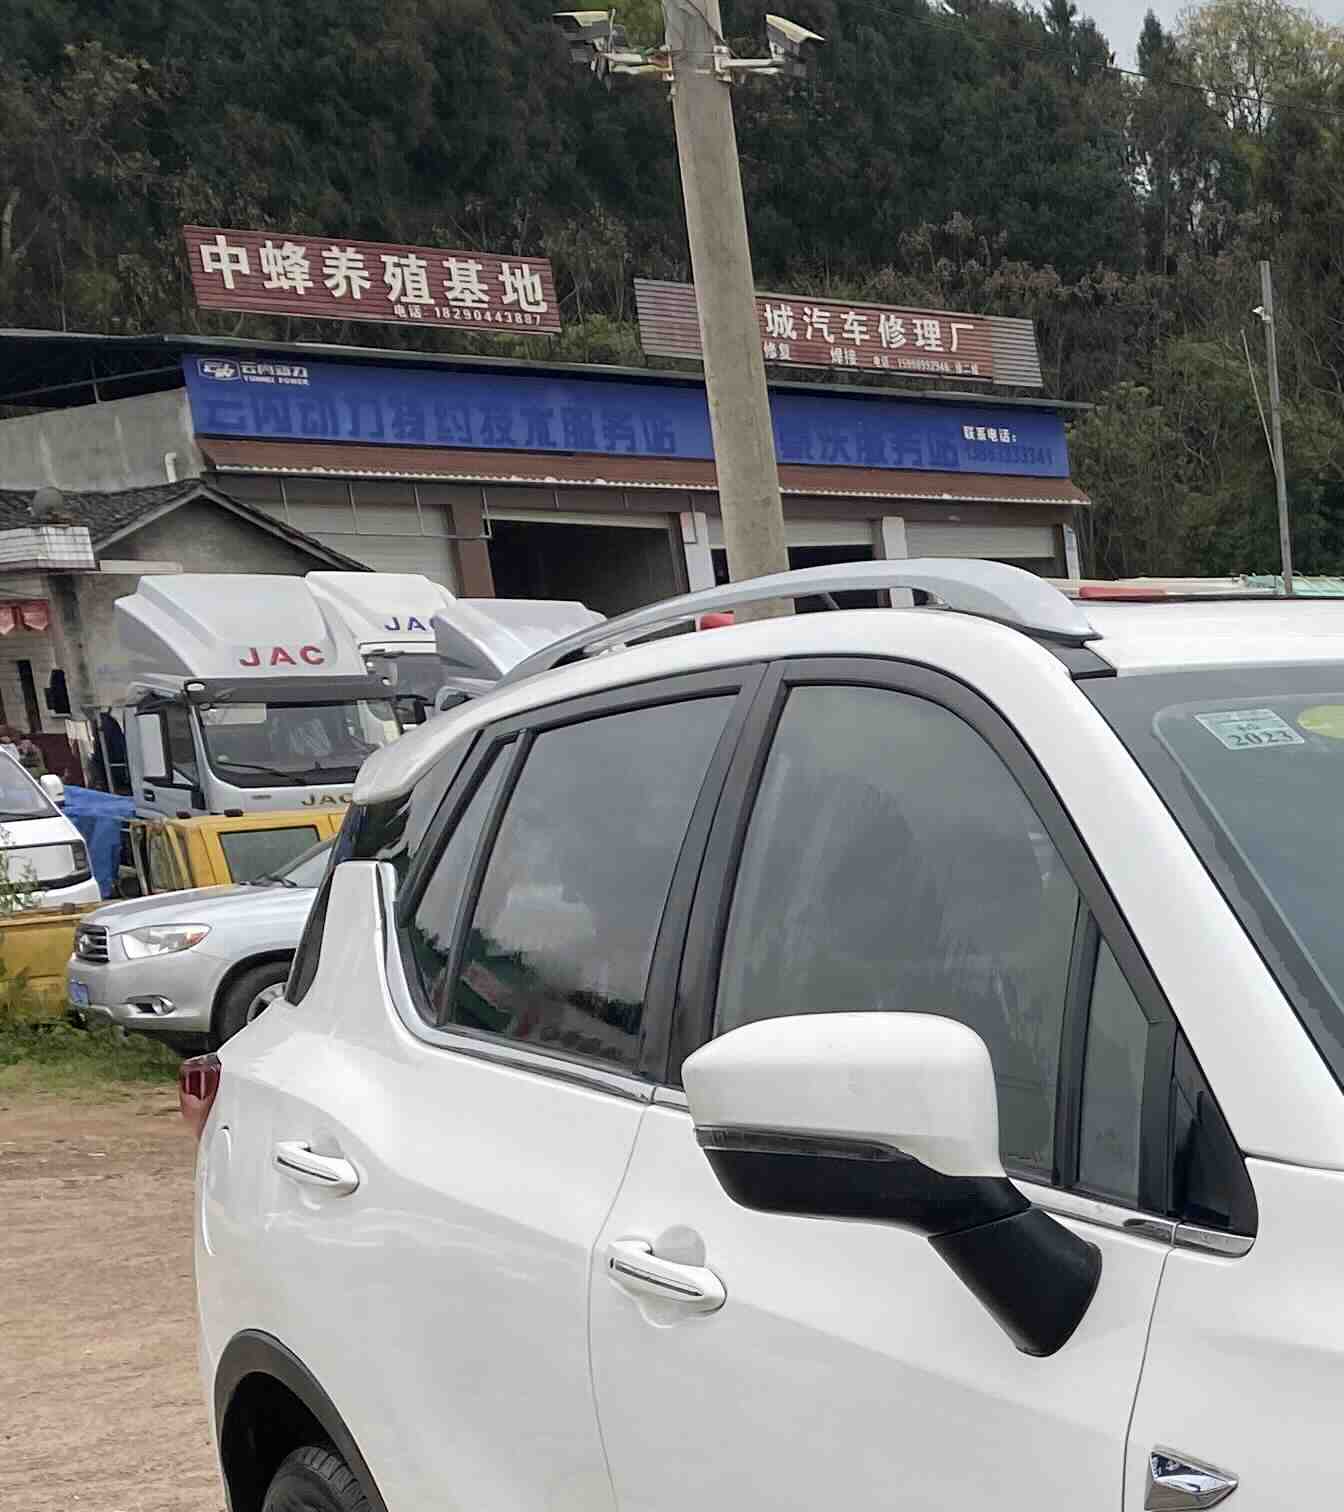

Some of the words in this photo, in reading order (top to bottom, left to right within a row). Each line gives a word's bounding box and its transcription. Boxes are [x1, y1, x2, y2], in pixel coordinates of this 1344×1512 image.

[199, 234, 548, 314] 中蜂养殖基地
[763, 302, 975, 353] 城汽车修理厂
[384, 617, 434, 631] JA
[239, 645, 325, 667] JAC
[1228, 730, 1294, 746] 2023
